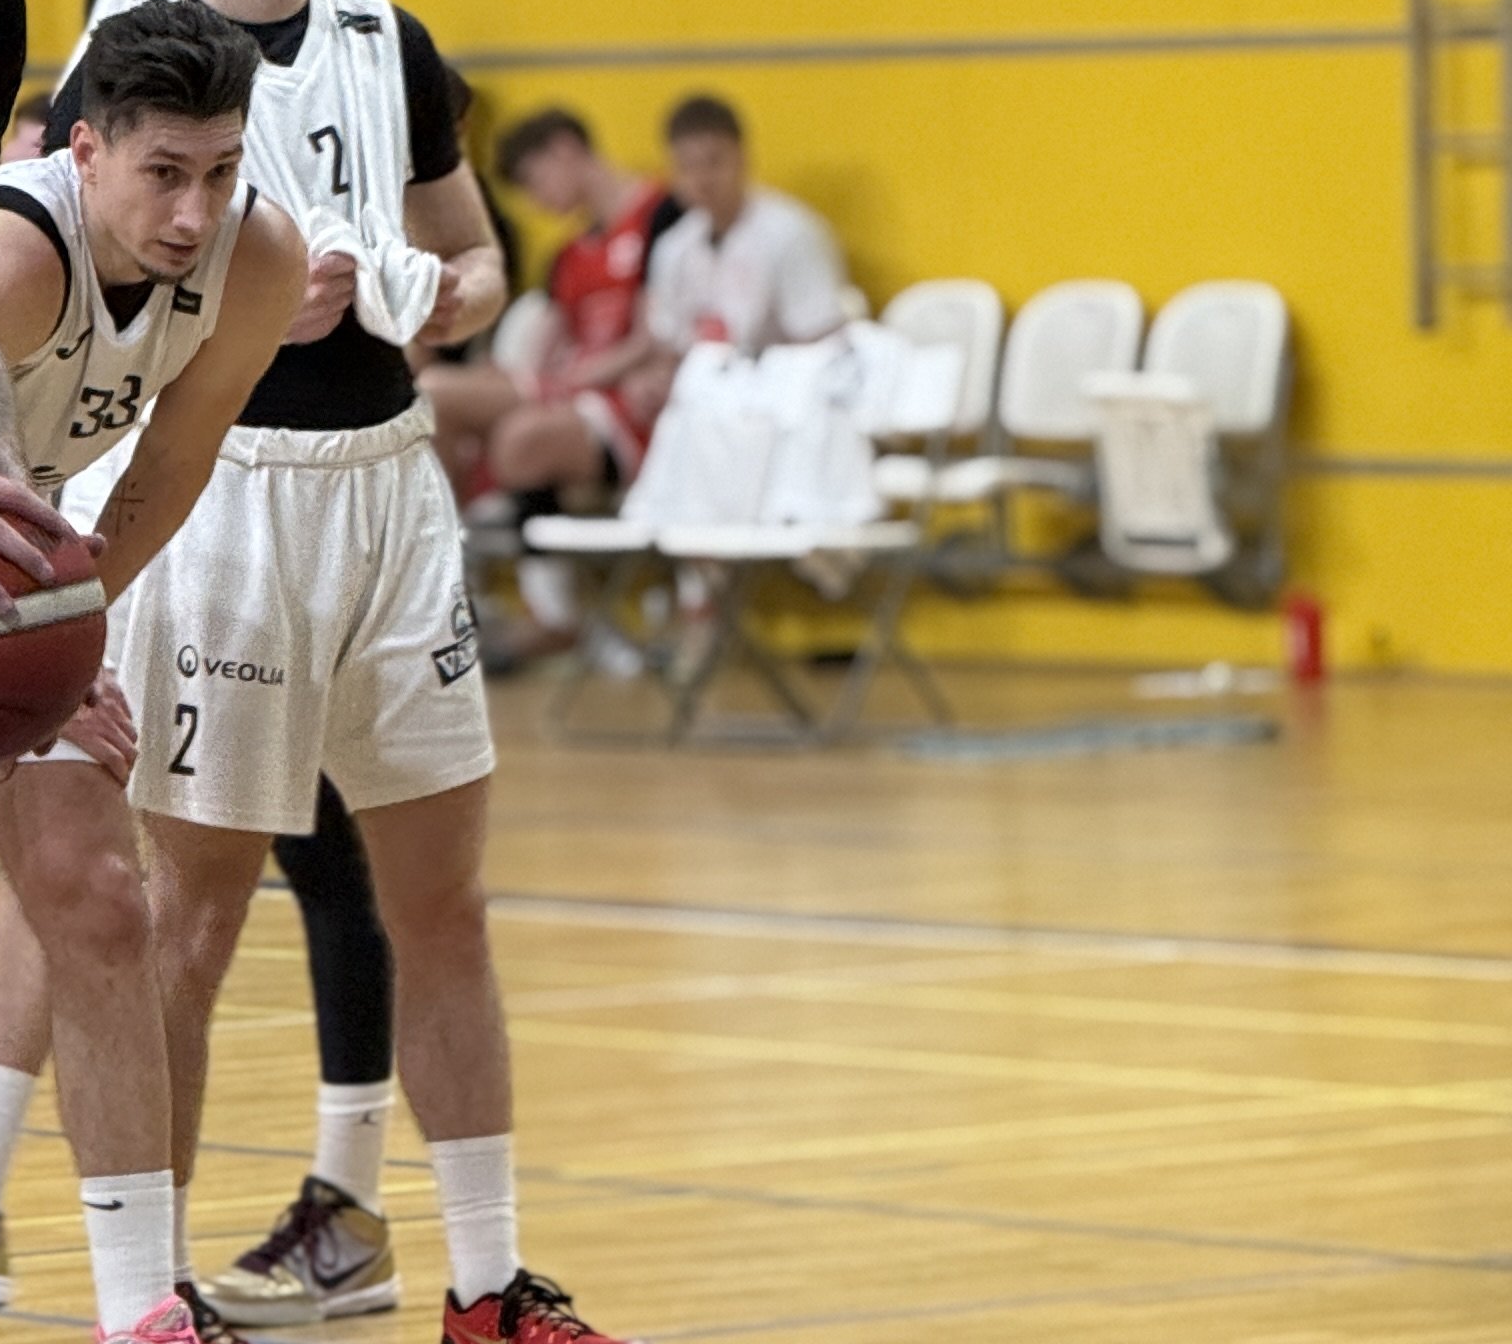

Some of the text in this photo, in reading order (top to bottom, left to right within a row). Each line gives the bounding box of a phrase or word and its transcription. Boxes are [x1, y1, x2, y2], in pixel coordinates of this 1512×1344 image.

[309, 125, 352, 195] 2
[68, 373, 143, 439] 33
[168, 703, 198, 777] 2
